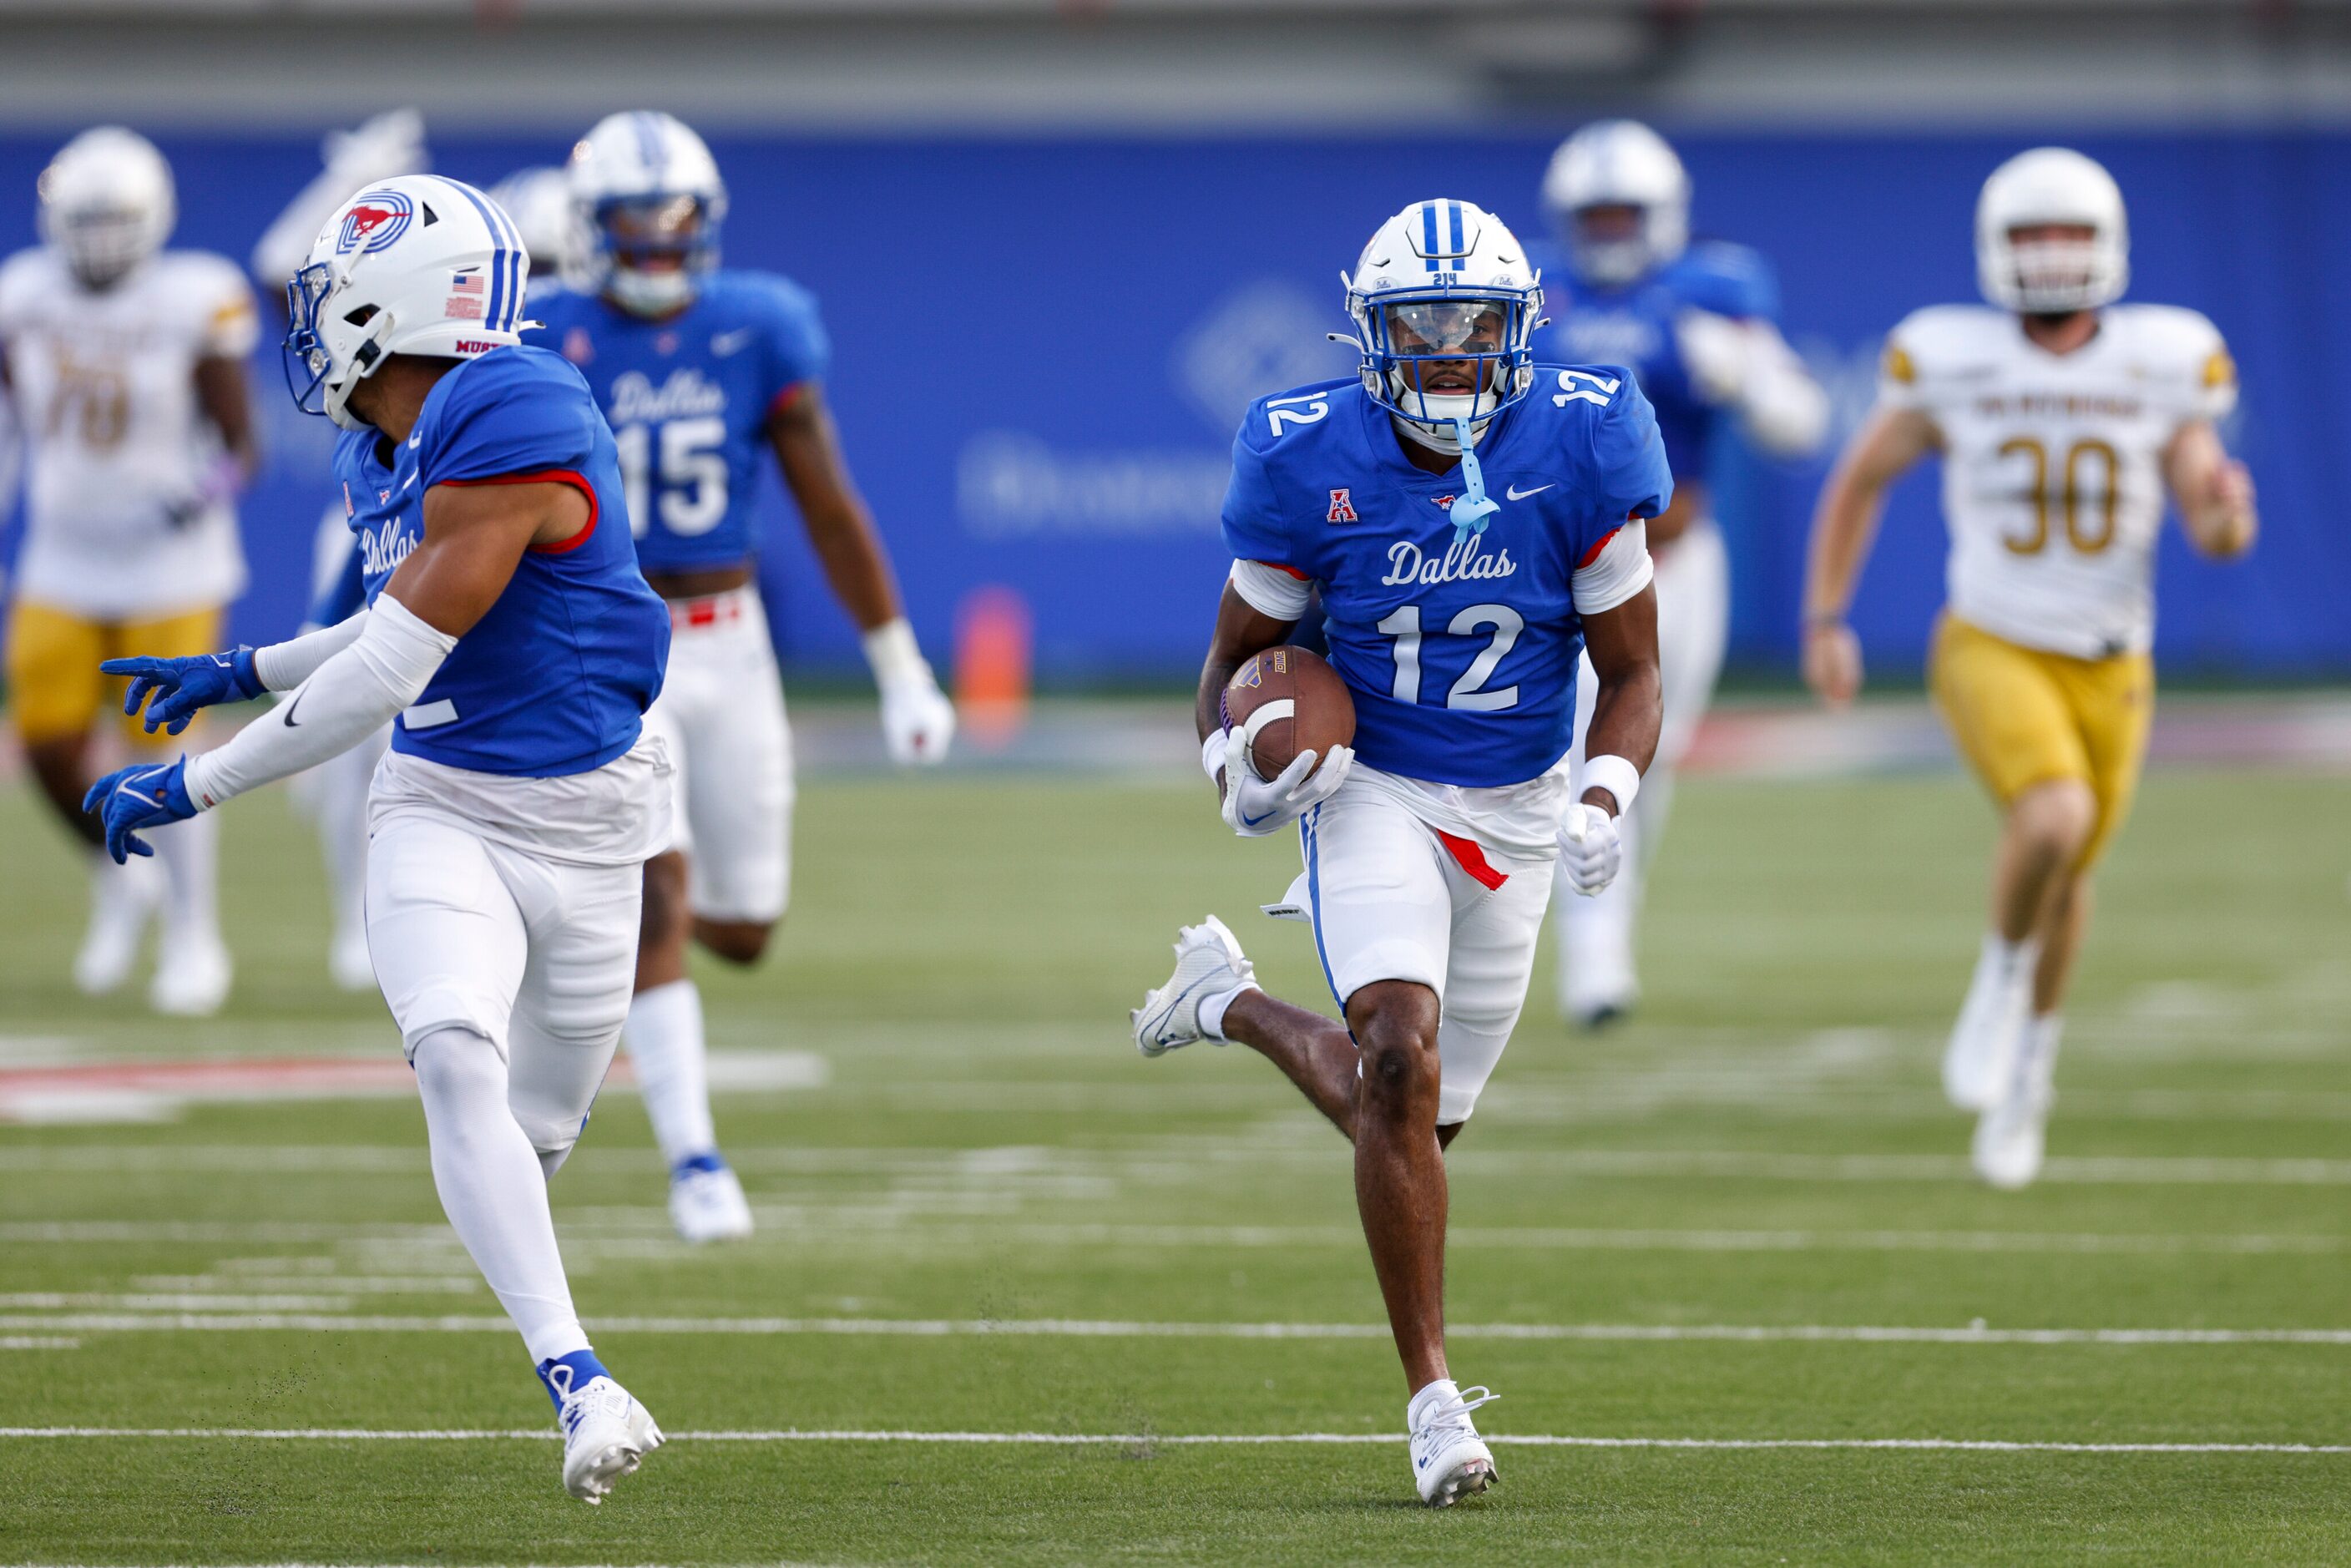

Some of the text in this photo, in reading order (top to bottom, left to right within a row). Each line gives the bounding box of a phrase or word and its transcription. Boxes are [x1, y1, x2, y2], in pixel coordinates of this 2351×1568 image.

[1433, 273, 1457, 286] 214
[1267, 392, 1329, 437] 12
[1552, 370, 1621, 407] 12
[616, 417, 729, 537] 15
[1997, 435, 2120, 556] 30
[1382, 533, 1517, 586] Dallas
[1377, 604, 1524, 711] 12
